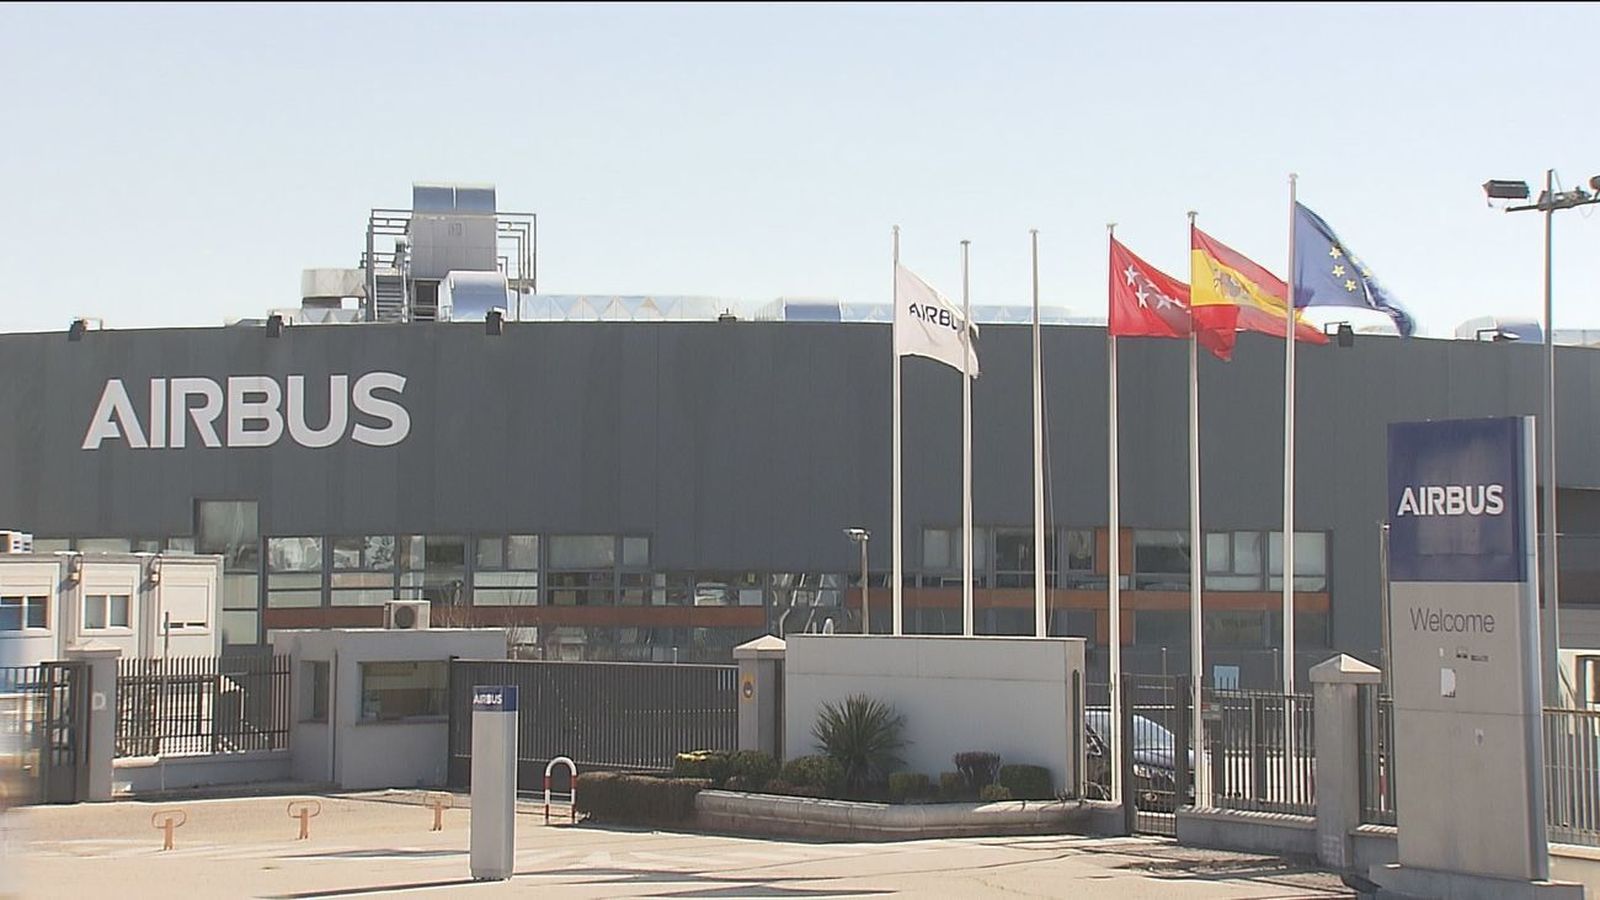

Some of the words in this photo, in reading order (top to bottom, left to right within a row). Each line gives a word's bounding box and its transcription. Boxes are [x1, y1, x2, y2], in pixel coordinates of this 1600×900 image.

[82, 371, 411, 450] AIRBUS
[1397, 484, 1504, 516] AIRBUS
[1409, 607, 1495, 633] Welcome
[472, 693, 503, 705] AIRBUS
